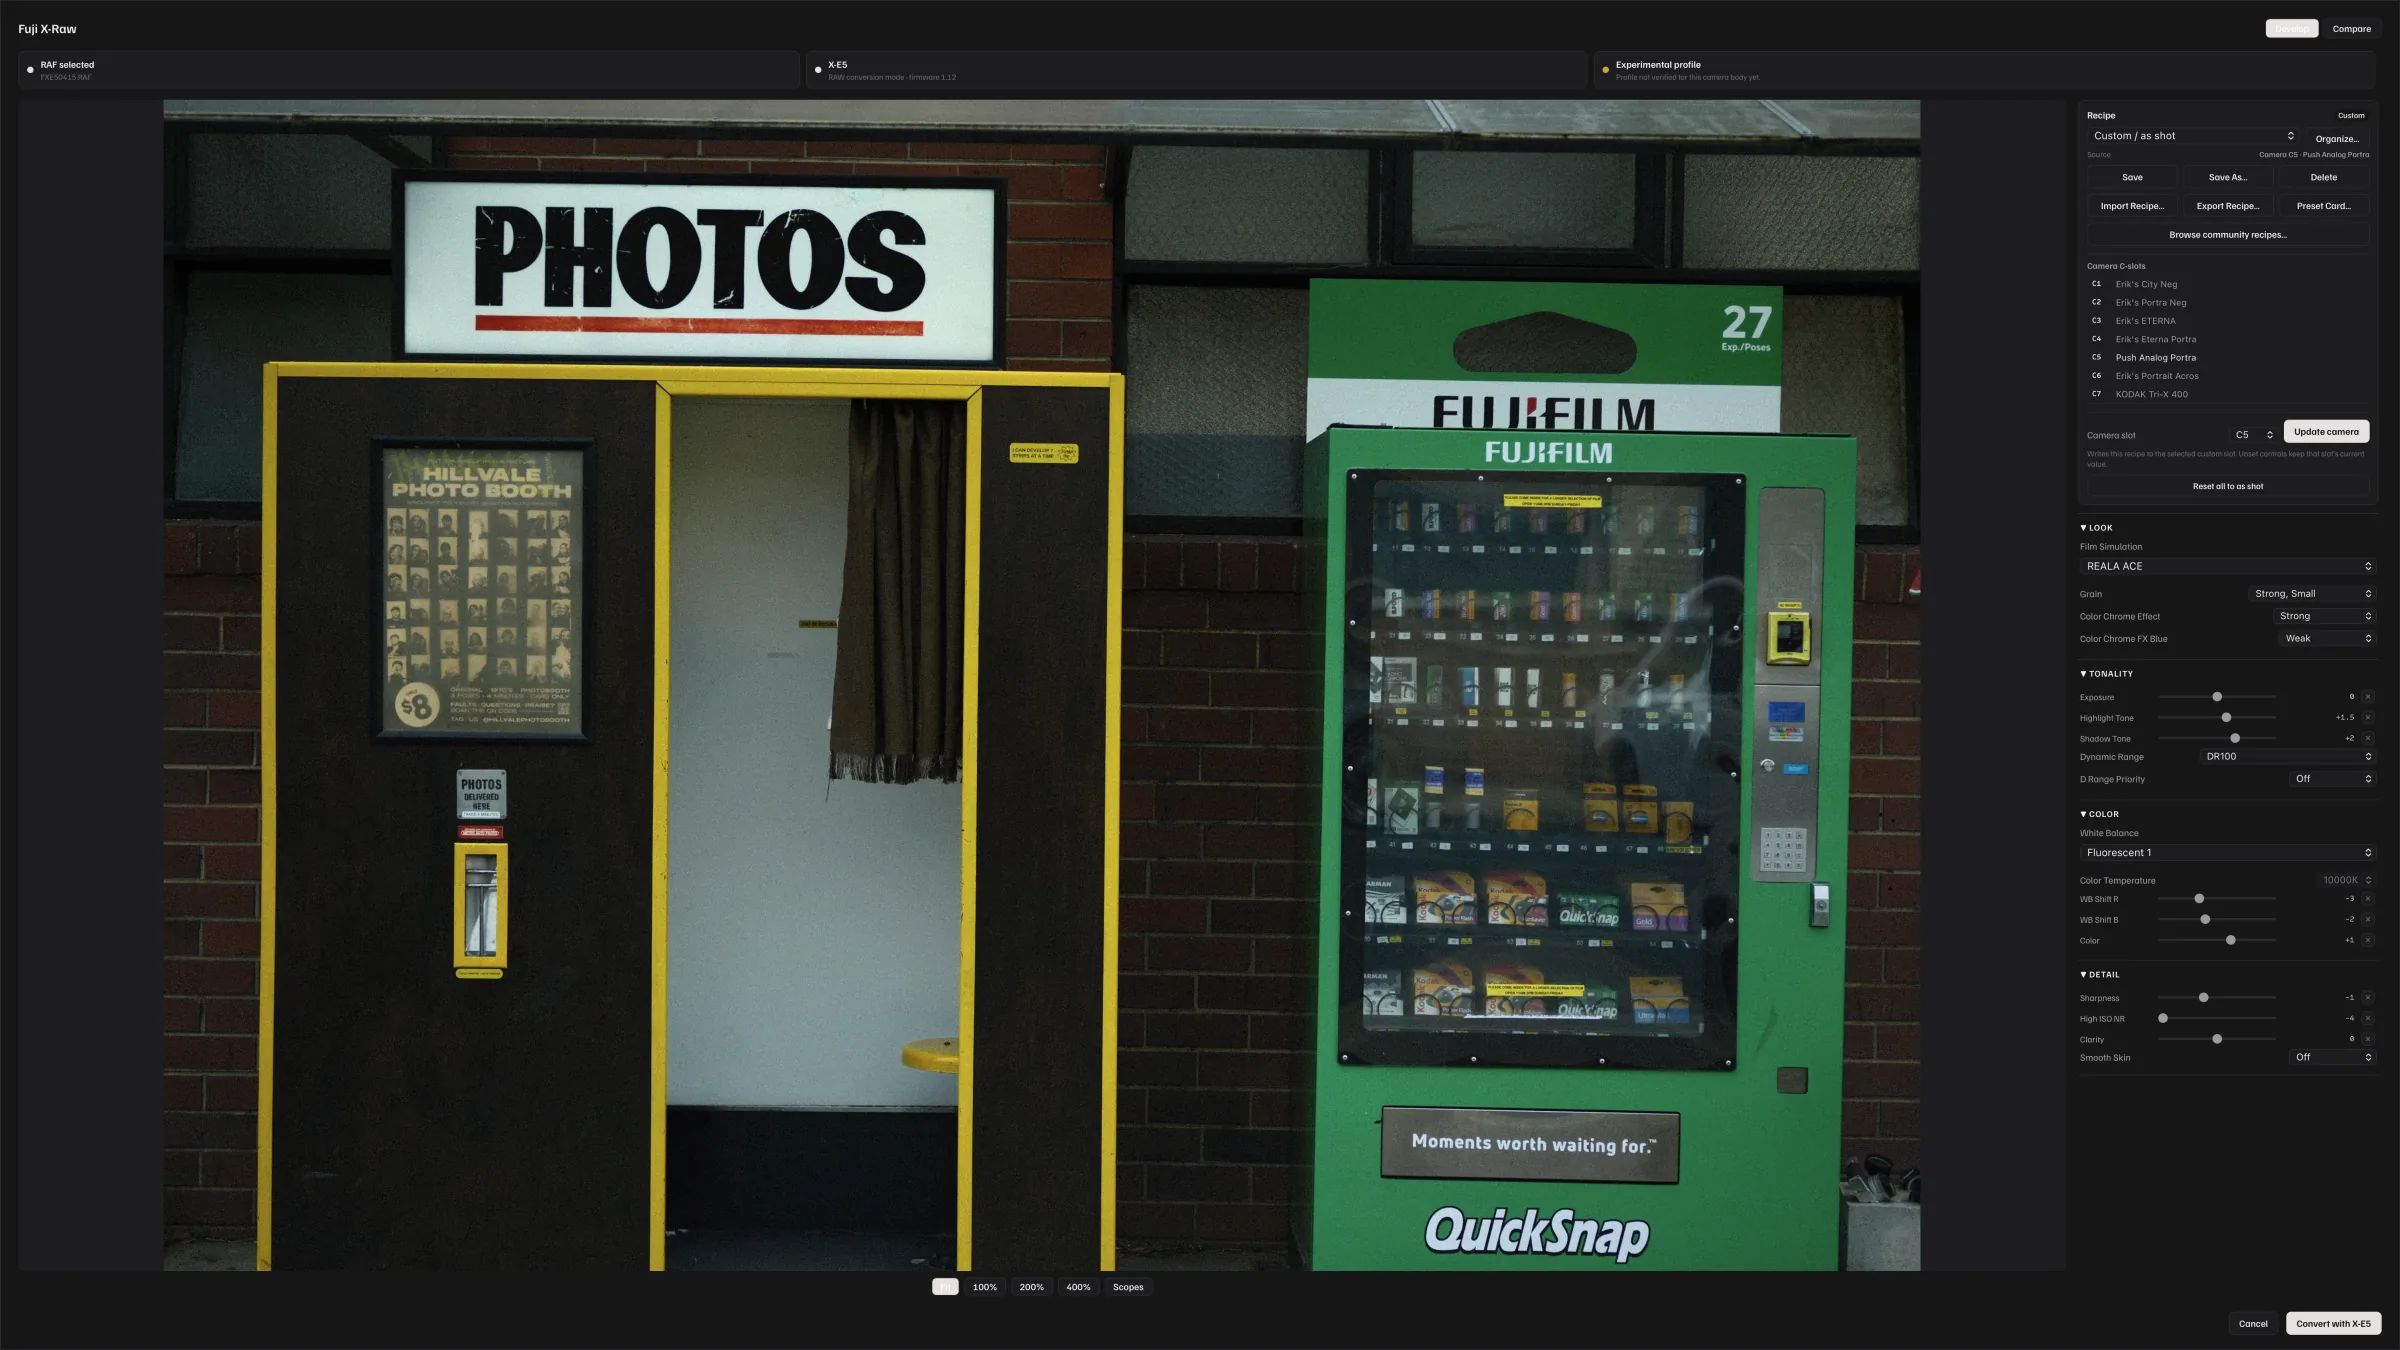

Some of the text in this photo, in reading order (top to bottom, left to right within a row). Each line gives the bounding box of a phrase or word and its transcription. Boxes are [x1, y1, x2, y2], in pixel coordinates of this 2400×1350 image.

[18, 24, 77, 36] Fuji X-Raw
[2332, 25, 2372, 34] Compare
[59, 61, 94, 69] selected
[1616, 60, 1701, 70] Experimental profile
[2087, 112, 2116, 120] Recipe
[2094, 131, 2132, 140] Custom
[2154, 131, 2176, 140] shot
[2316, 135, 2360, 144] Organize...
[2122, 173, 2143, 181] Save
[2209, 173, 2248, 181] Save As...
[2310, 173, 2338, 181] Delete
[2101, 202, 2165, 212] Import Recipe...
[2170, 230, 2288, 240] Browse community recipes...
[476, 206, 926, 312] PHOTOS
[2141, 280, 2158, 290] City
[2160, 280, 2178, 290] Neg
[1721, 305, 1773, 339] 27
[1721, 342, 1771, 353] Exp./Poses
[2116, 354, 2196, 363] Push Analog Portra
[2116, 390, 2188, 398] KODAK Tri-X 400
[1434, 396, 1655, 431] FUJIFILM
[2294, 428, 2326, 437] Update
[1484, 442, 1613, 464] FUJIFILM
[423, 467, 541, 482] HILLVALE
[392, 483, 572, 498] PHOTO BOOTH
[2087, 562, 2142, 571] REALA ACE
[2256, 589, 2316, 600] Strong, Small
[2080, 692, 2114, 702] Exposure
[400, 694, 433, 720] $8
[2080, 714, 2114, 723] Highlight
[2080, 753, 2144, 762] Dynamic Range
[2207, 752, 2236, 760] DR100
[461, 779, 502, 790] PHOTOS
[2087, 848, 2151, 857] Fluorescent 1
[1412, 1133, 1491, 1150] Moments
[1497, 1137, 1547, 1152] worth
[1552, 1138, 1616, 1156] waiting
[1424, 1206, 1651, 1264] QuickSnap
[1113, 1283, 1144, 1292] Scopes
[2296, 1320, 2330, 1328] Convert
